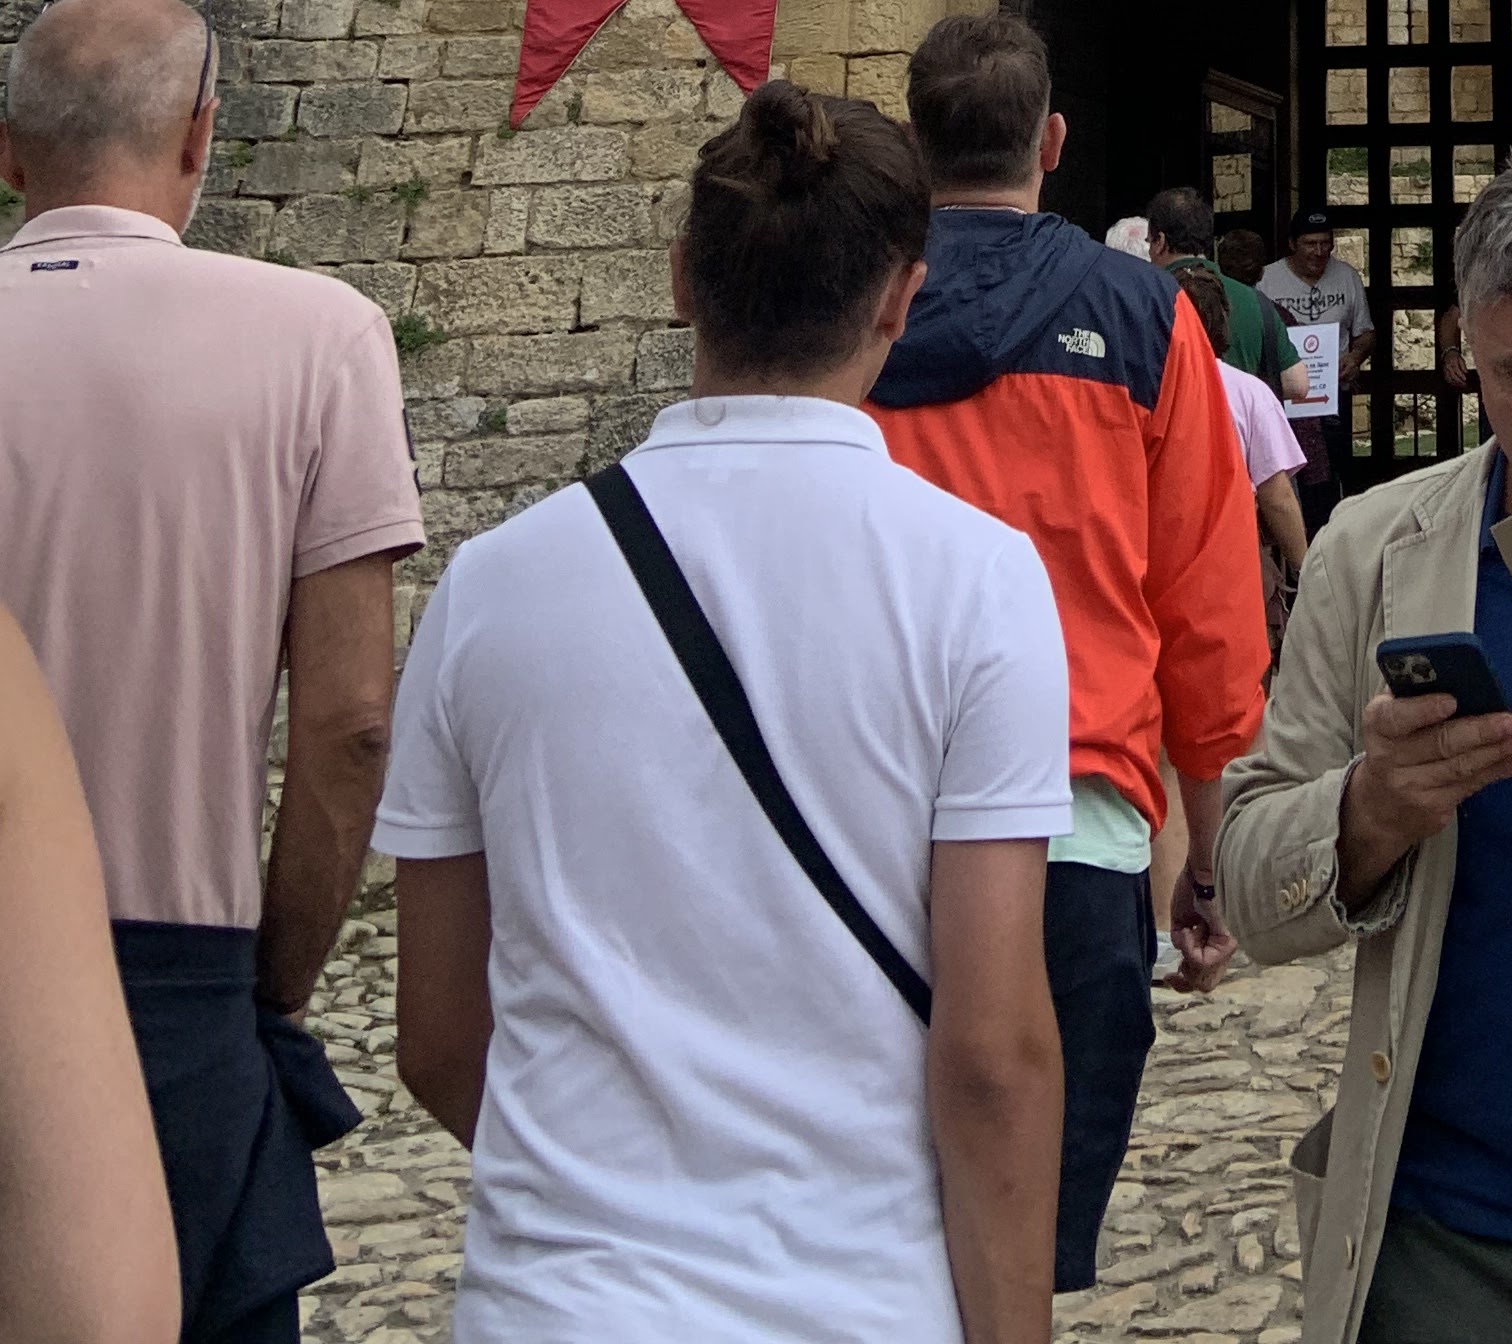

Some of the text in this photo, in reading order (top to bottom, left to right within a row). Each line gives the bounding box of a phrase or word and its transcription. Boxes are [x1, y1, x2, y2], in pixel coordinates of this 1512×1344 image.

[1073, 328, 1090, 338] THE
[1058, 333, 1090, 347] NORTH
[1065, 343, 1090, 355] FACE
